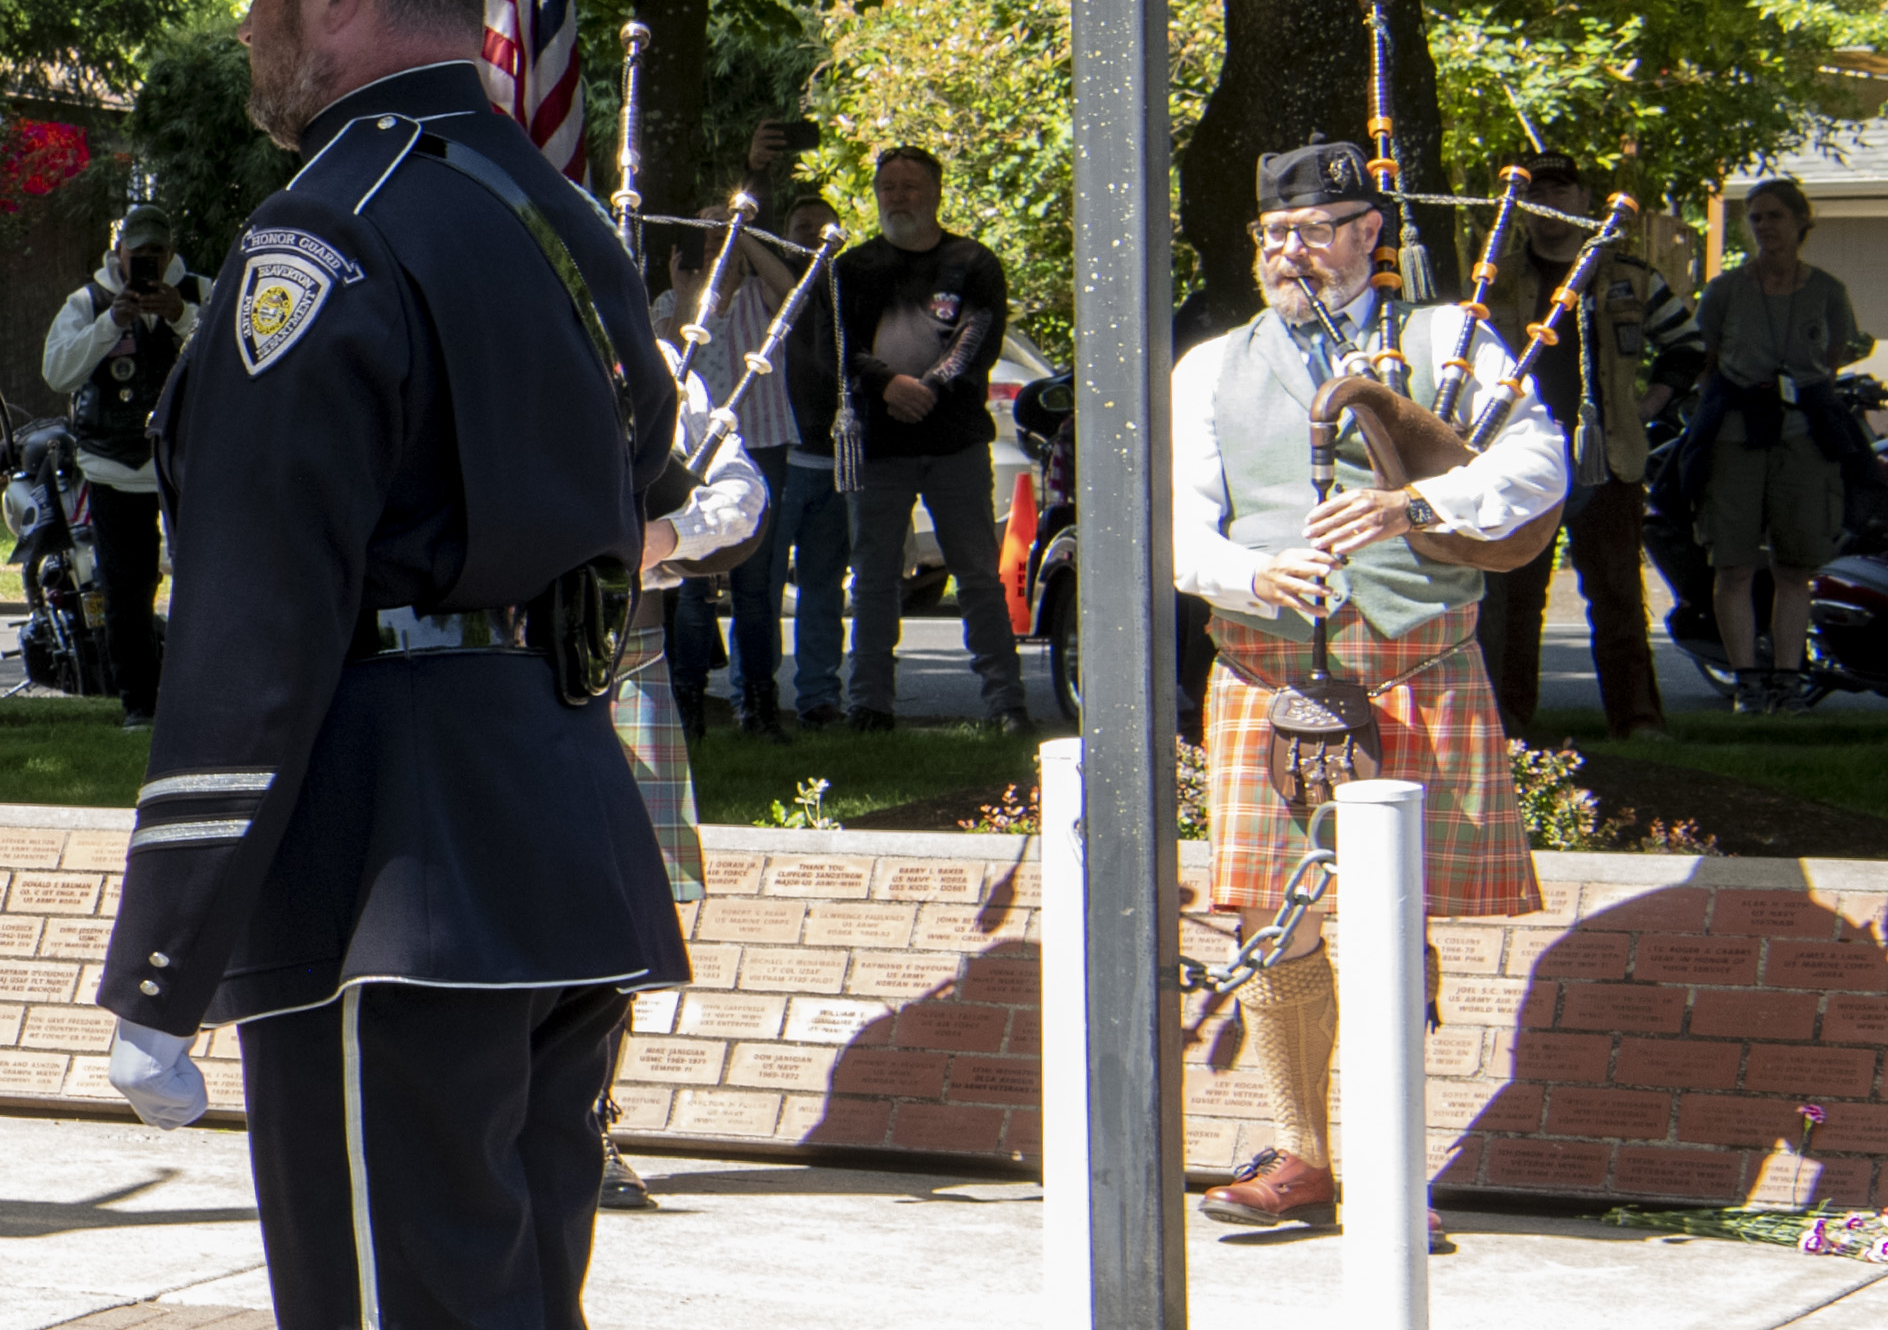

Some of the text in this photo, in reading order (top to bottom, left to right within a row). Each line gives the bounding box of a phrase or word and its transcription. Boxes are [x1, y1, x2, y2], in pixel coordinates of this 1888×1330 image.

[251, 234, 342, 269] HONOR GUARD
[258, 265, 315, 288] BEAVERTON
[242, 295, 252, 338] POLICE
[256, 289, 316, 356] DEPARTMENT
[828, 864, 845, 872] YOU
[777, 871, 813, 879] CLIFFORD
[21, 880, 92, 890] DONALD BAUMAN
[775, 879, 801, 887] MAJOR
[764, 918, 791, 926] CORPS
[1197, 936, 1223, 945] NAVY
[1443, 938, 1481, 946] COLLINS
[861, 962, 903, 970] RAYMOND
[913, 981, 932, 989] WAR
[1456, 987, 1478, 995] JOEL
[1448, 996, 1491, 1005] US ARMY
[1458, 1006, 1492, 1014] WORLD
[68, 1017, 102, 1025] FREEDOM
[645, 1047, 706, 1056] MIKE JANIGIAN
[774, 1054, 812, 1063] JANIGIAN
[777, 1063, 800, 1071] NAVY
[1233, 1082, 1265, 1090] KOGAN
